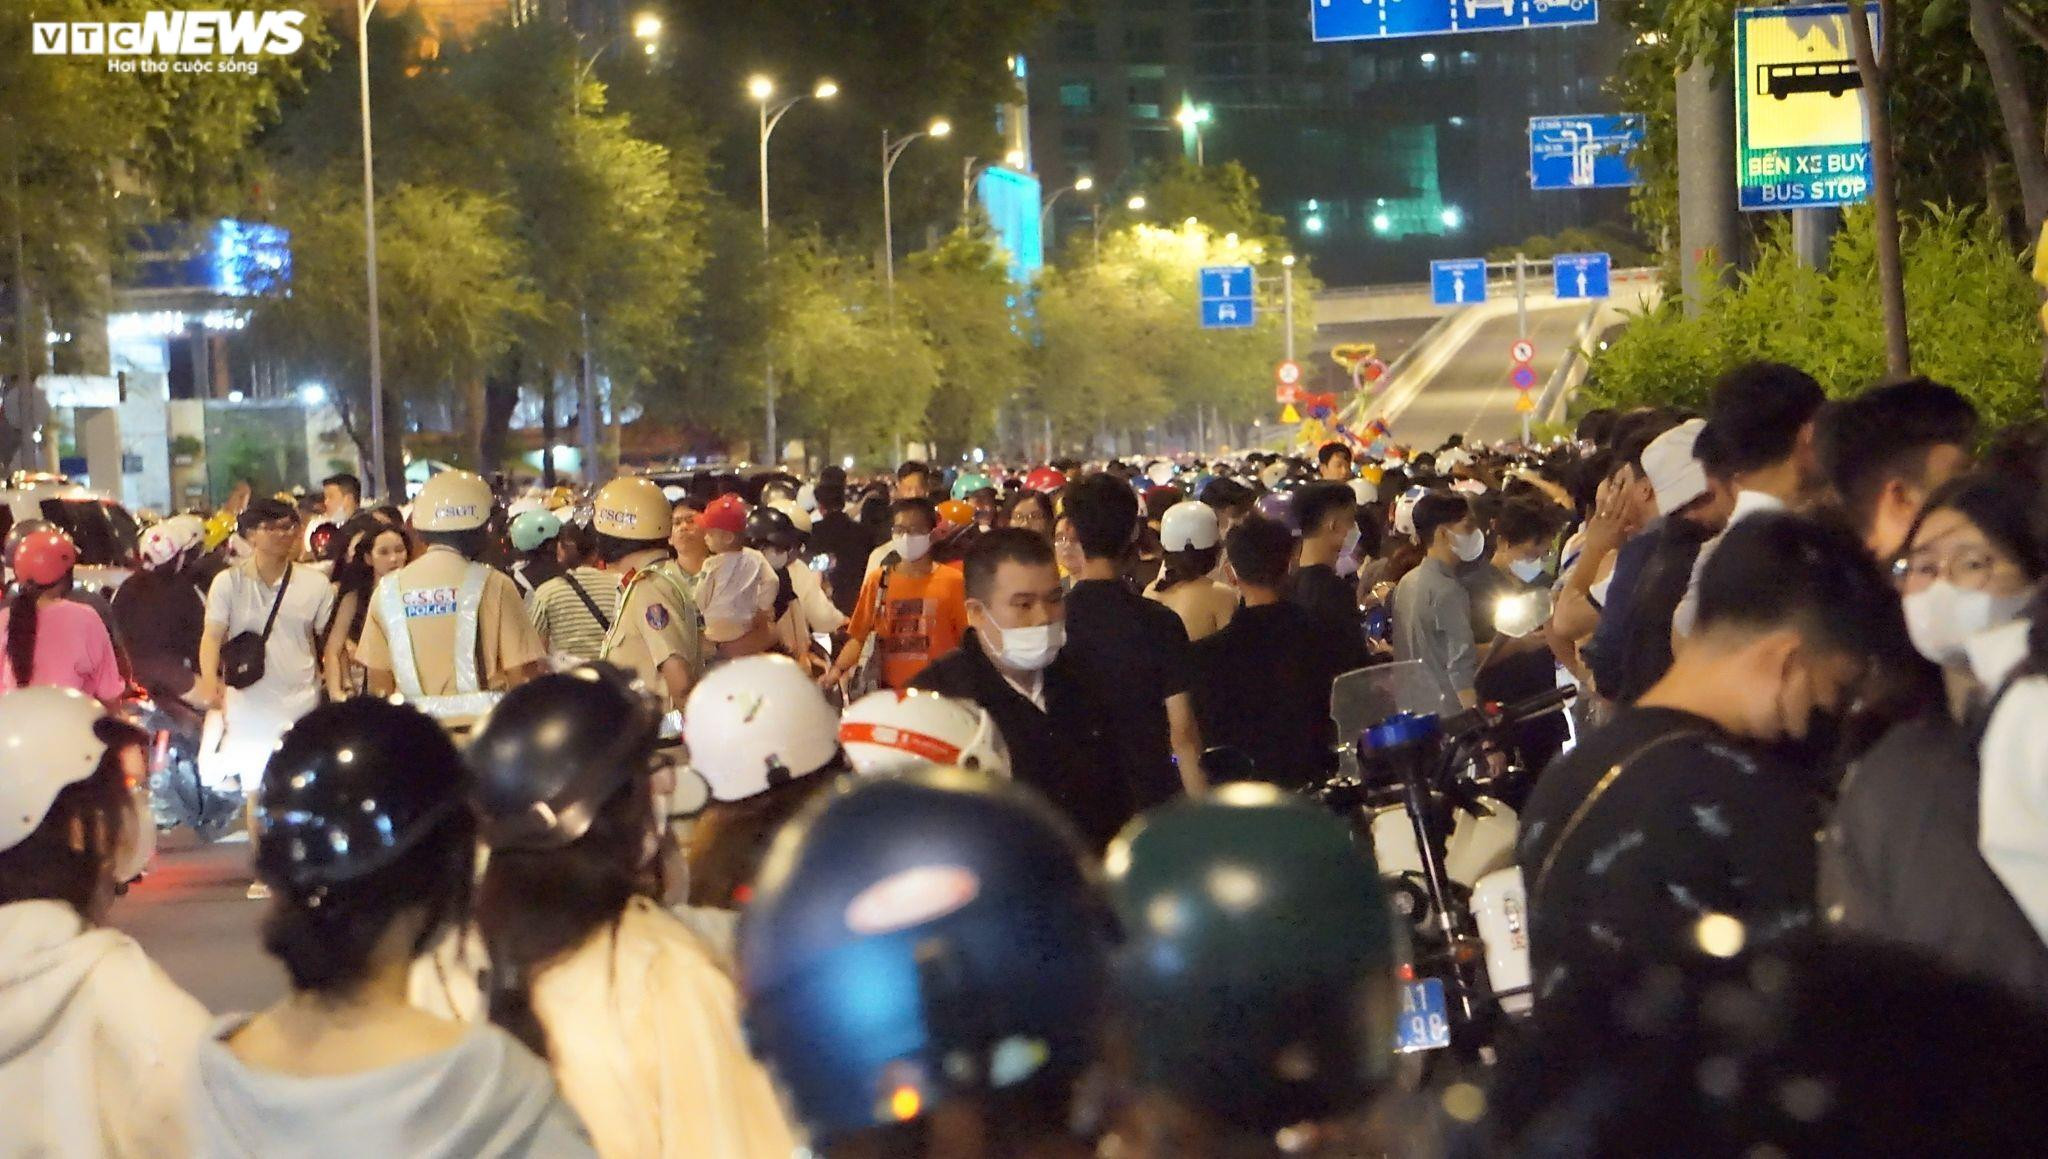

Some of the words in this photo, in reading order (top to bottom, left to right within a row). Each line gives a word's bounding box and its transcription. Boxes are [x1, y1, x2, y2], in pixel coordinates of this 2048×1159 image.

[1748, 150, 1790, 176] BẾN
[1762, 183, 1805, 202] BUS
[1811, 176, 1867, 200] STOP
[600, 507, 637, 525] CSGT
[407, 602, 455, 617] POLICE
